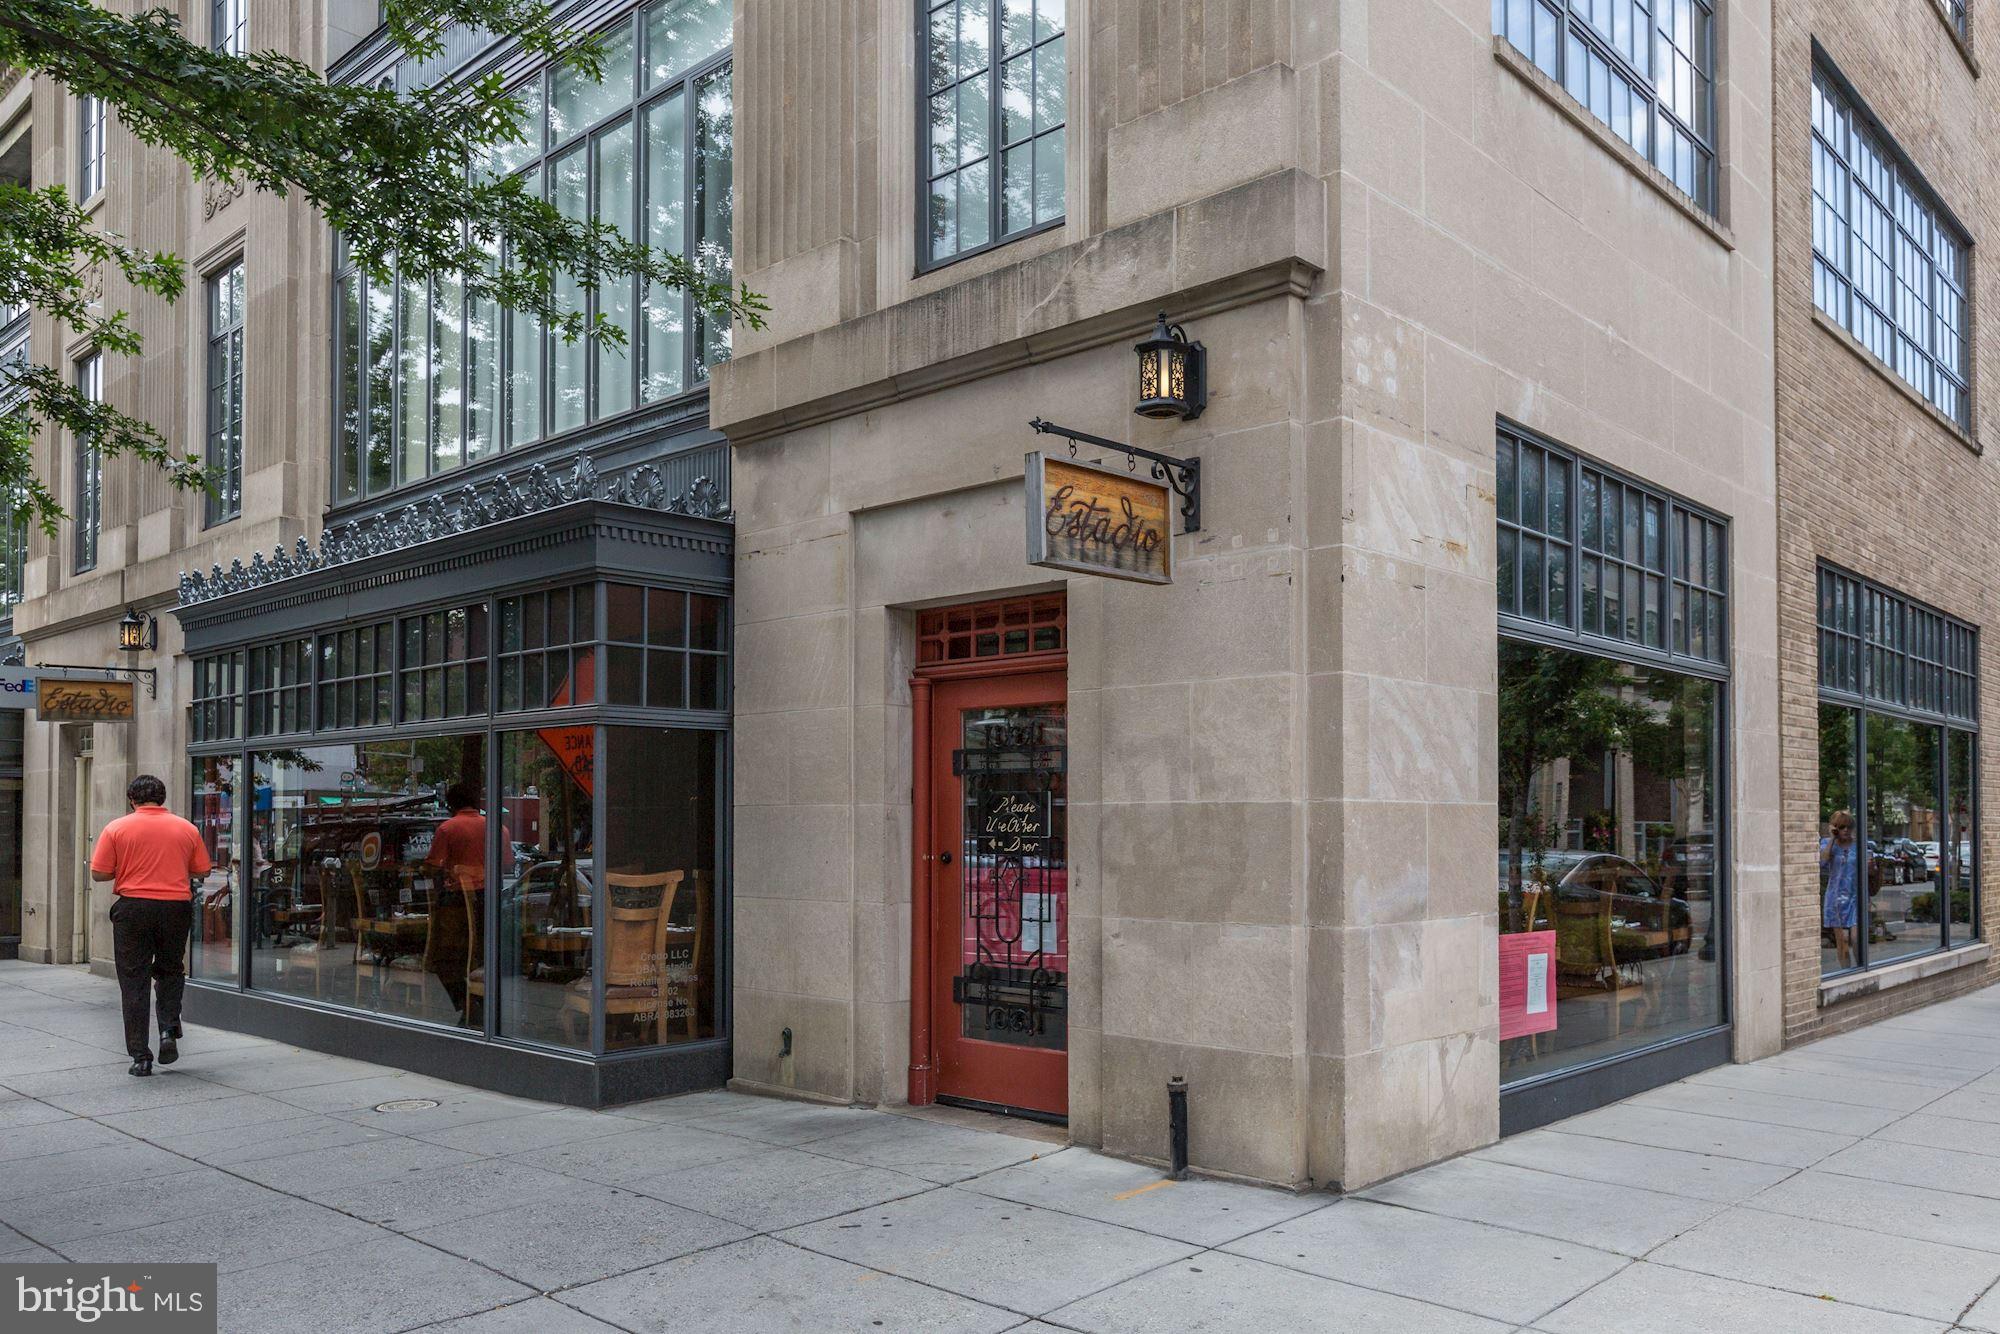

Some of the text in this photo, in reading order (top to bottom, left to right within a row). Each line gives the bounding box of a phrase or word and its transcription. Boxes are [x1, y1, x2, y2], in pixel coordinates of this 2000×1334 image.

[1045, 485, 1161, 552] Estadio
[0, 678, 36, 693] FedE
[43, 687, 131, 713] Estadio
[671, 949, 689, 959] LLC
[633, 1011, 660, 1023] ABRA
